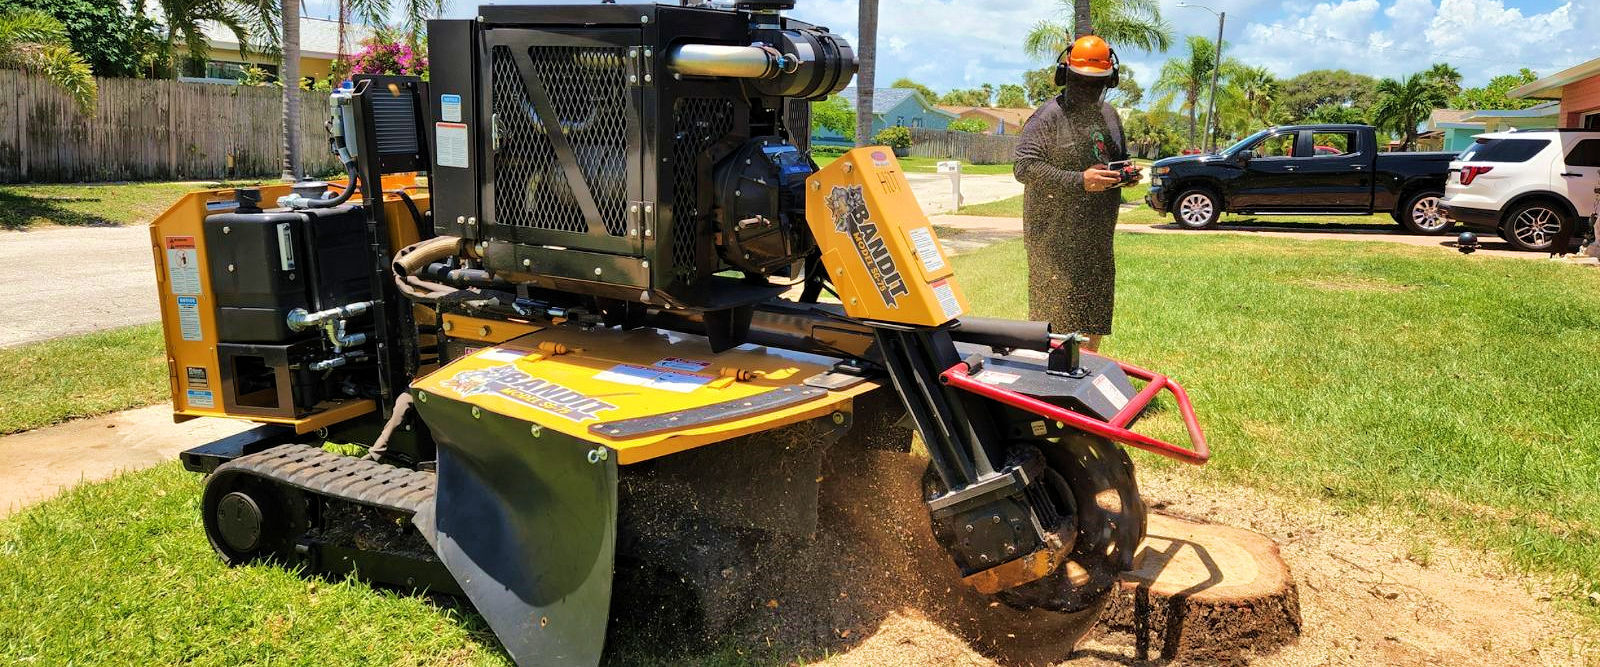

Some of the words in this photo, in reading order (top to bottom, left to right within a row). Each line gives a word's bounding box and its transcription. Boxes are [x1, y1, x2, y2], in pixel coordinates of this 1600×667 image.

[851, 204, 909, 298] BANDIT
[853, 232, 874, 267] MODEL
[496, 370, 618, 414] BANDIT
